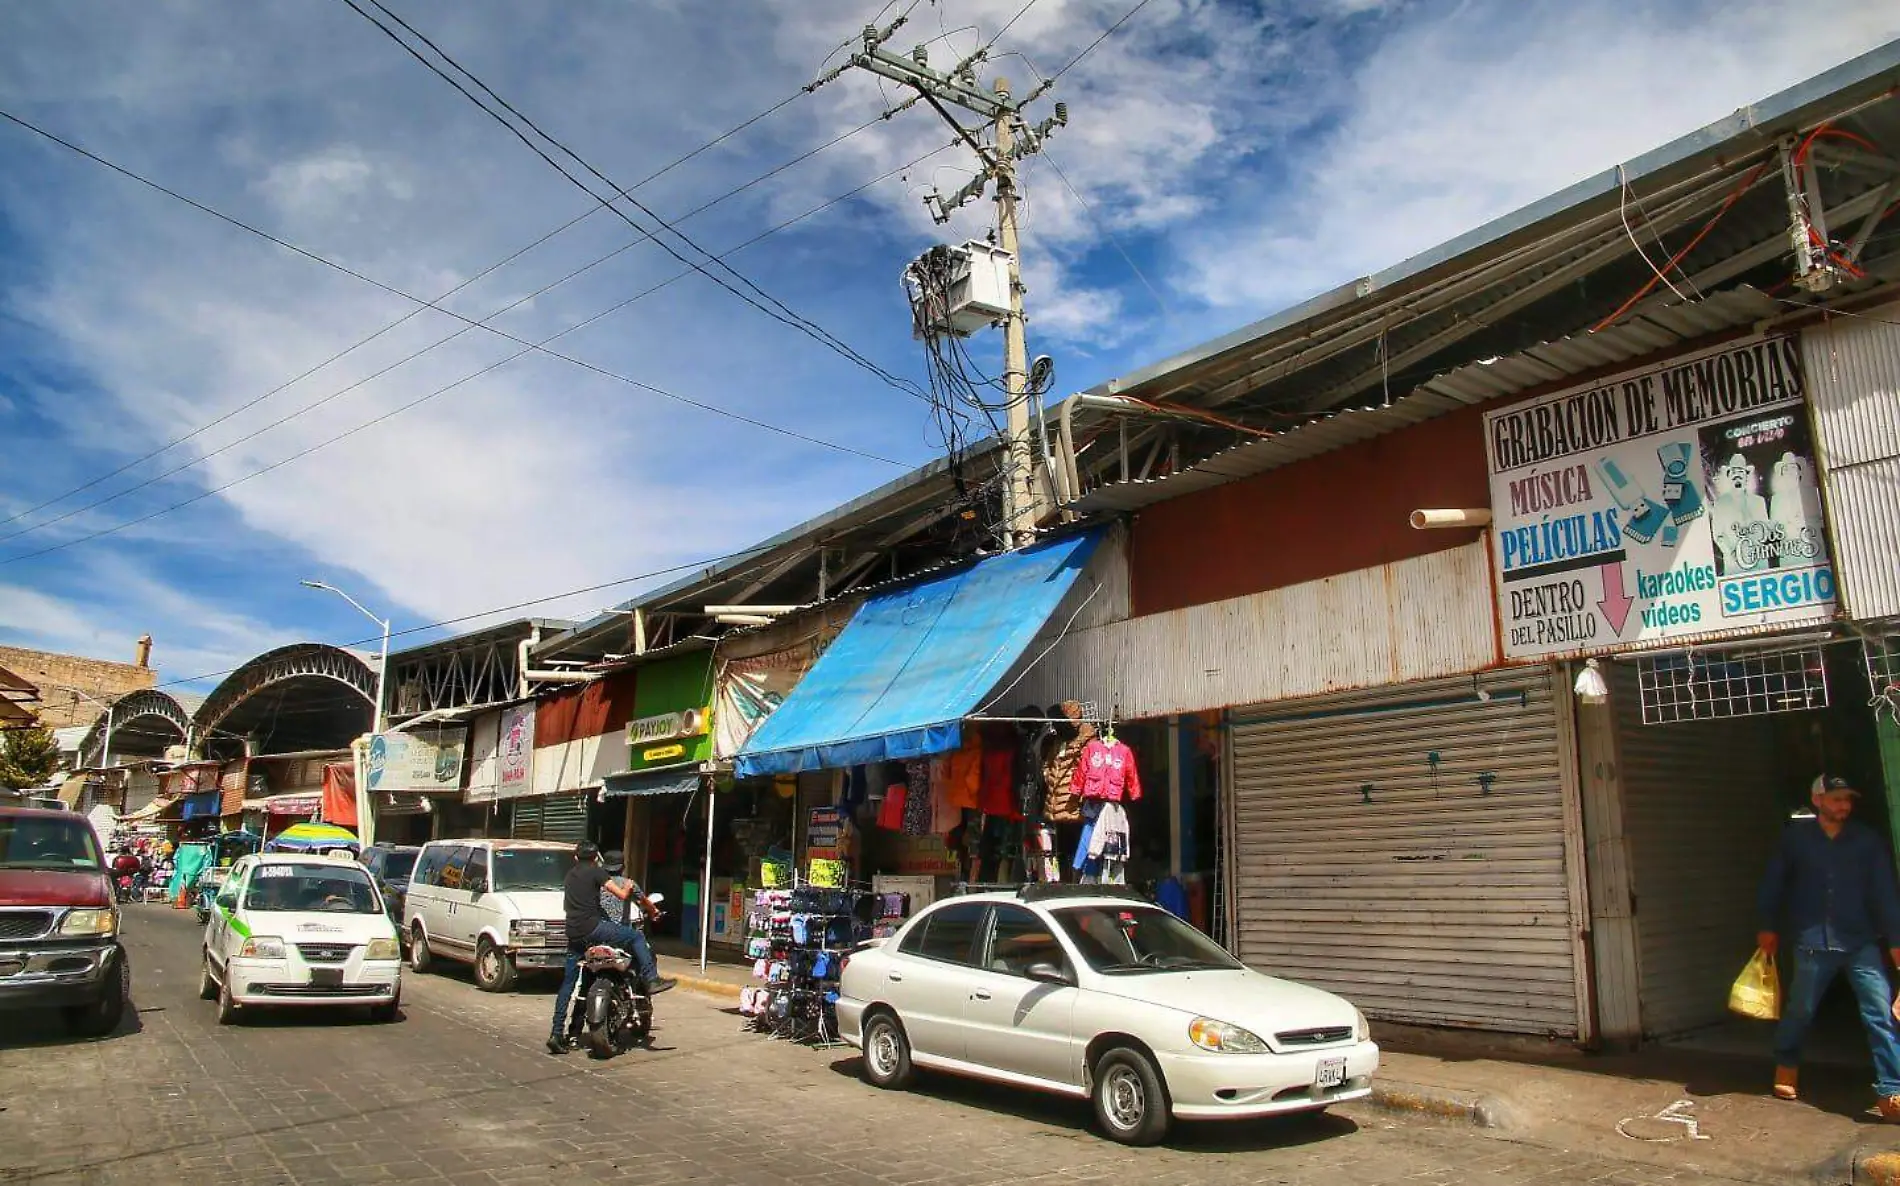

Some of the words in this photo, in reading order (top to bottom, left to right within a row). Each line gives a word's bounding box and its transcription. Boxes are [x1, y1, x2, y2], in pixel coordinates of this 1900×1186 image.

[1494, 387, 1620, 469] GRABACION
[1622, 376, 1659, 438] DE
[1661, 337, 1802, 428] MEMORIAS
[1725, 415, 1794, 439] CONCIERTO
[1509, 464, 1594, 517] MÚSICA
[1500, 507, 1622, 569] PELÍCULAS
[1510, 579, 1585, 621] DENTRO
[1636, 561, 1716, 600] karaokes
[1723, 566, 1836, 614] SERGIO
[1511, 625, 1536, 647] DEL
[1536, 611, 1597, 646] PASILLO
[1640, 601, 1702, 629] videos
[640, 717, 674, 737] PAYJOY
